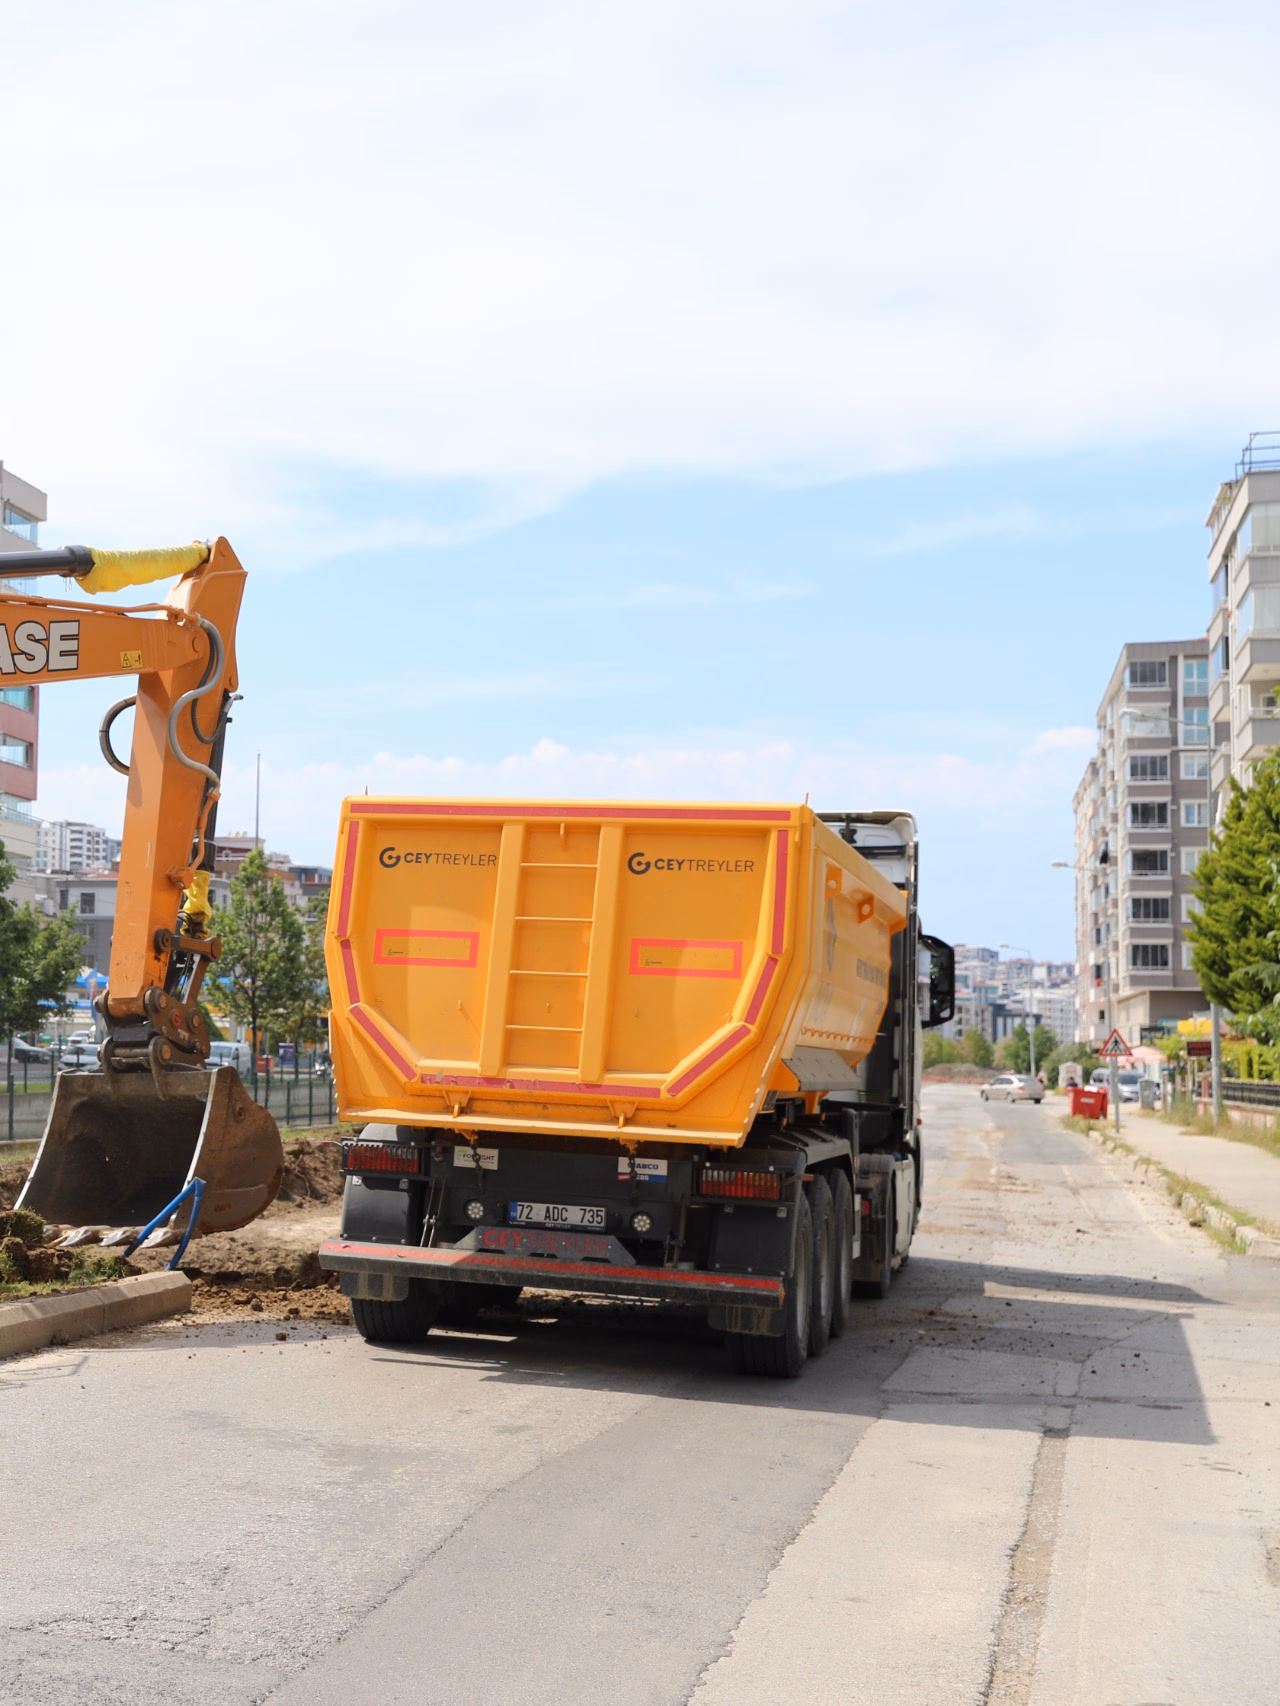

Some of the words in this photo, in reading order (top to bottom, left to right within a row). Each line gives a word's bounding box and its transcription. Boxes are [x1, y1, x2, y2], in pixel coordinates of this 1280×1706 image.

[404, 852, 498, 867] CEYTREYLER
[654, 858, 755, 873] CEYTREYLER
[517, 1204, 533, 1220] 72
[544, 1206, 568, 1222] ADC
[579, 1208, 604, 1225] 735
[483, 1229, 608, 1255] CEYTREYLER
